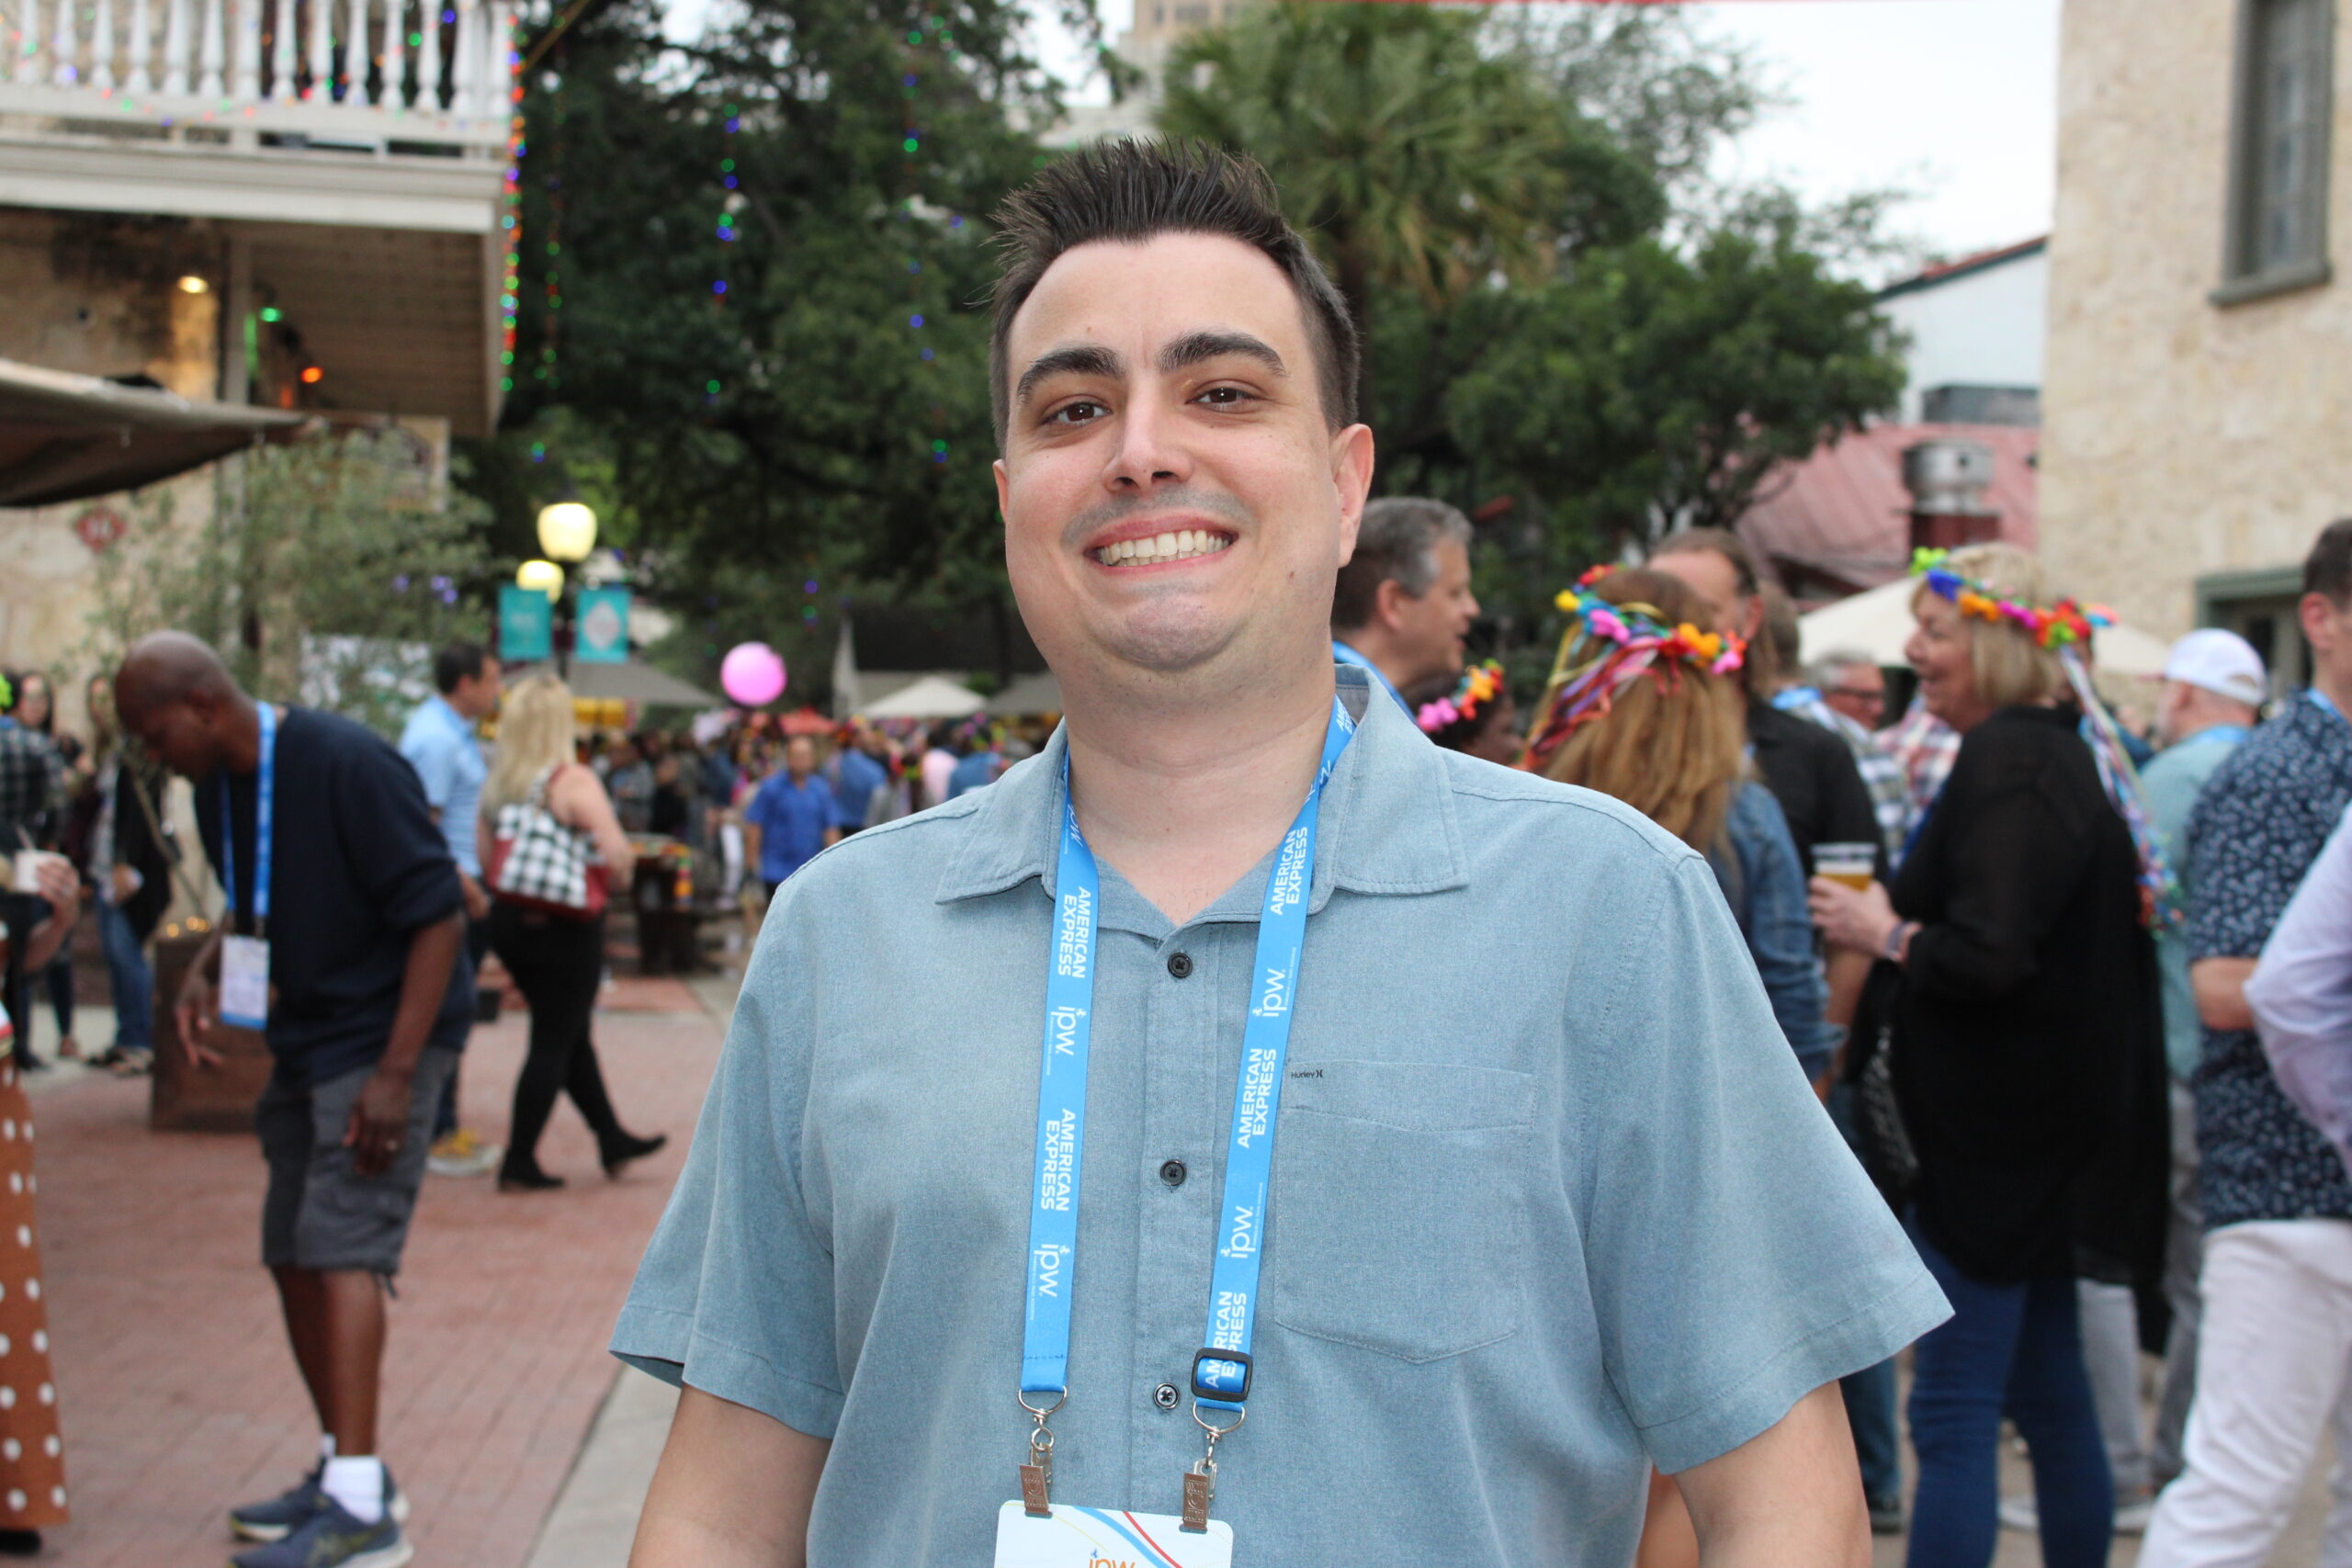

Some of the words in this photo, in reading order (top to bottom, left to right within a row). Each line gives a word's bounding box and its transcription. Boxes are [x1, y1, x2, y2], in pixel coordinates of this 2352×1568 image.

[1270, 829, 1297, 916] AMERICAN
[1285, 827, 1308, 905] EXPRESS
[1057, 894, 1078, 976] EXPRESS
[1071, 886, 1091, 978] AMERICAN
[1237, 1048, 1264, 1148] AMERICAN
[1251, 1048, 1277, 1137] EXPRESS
[1291, 1070, 1315, 1079] Hurley
[1040, 1119, 1061, 1211] EXPRESS
[1056, 1108, 1077, 1212] AMERICAN
[1204, 1291, 1233, 1389] AMRICAN
